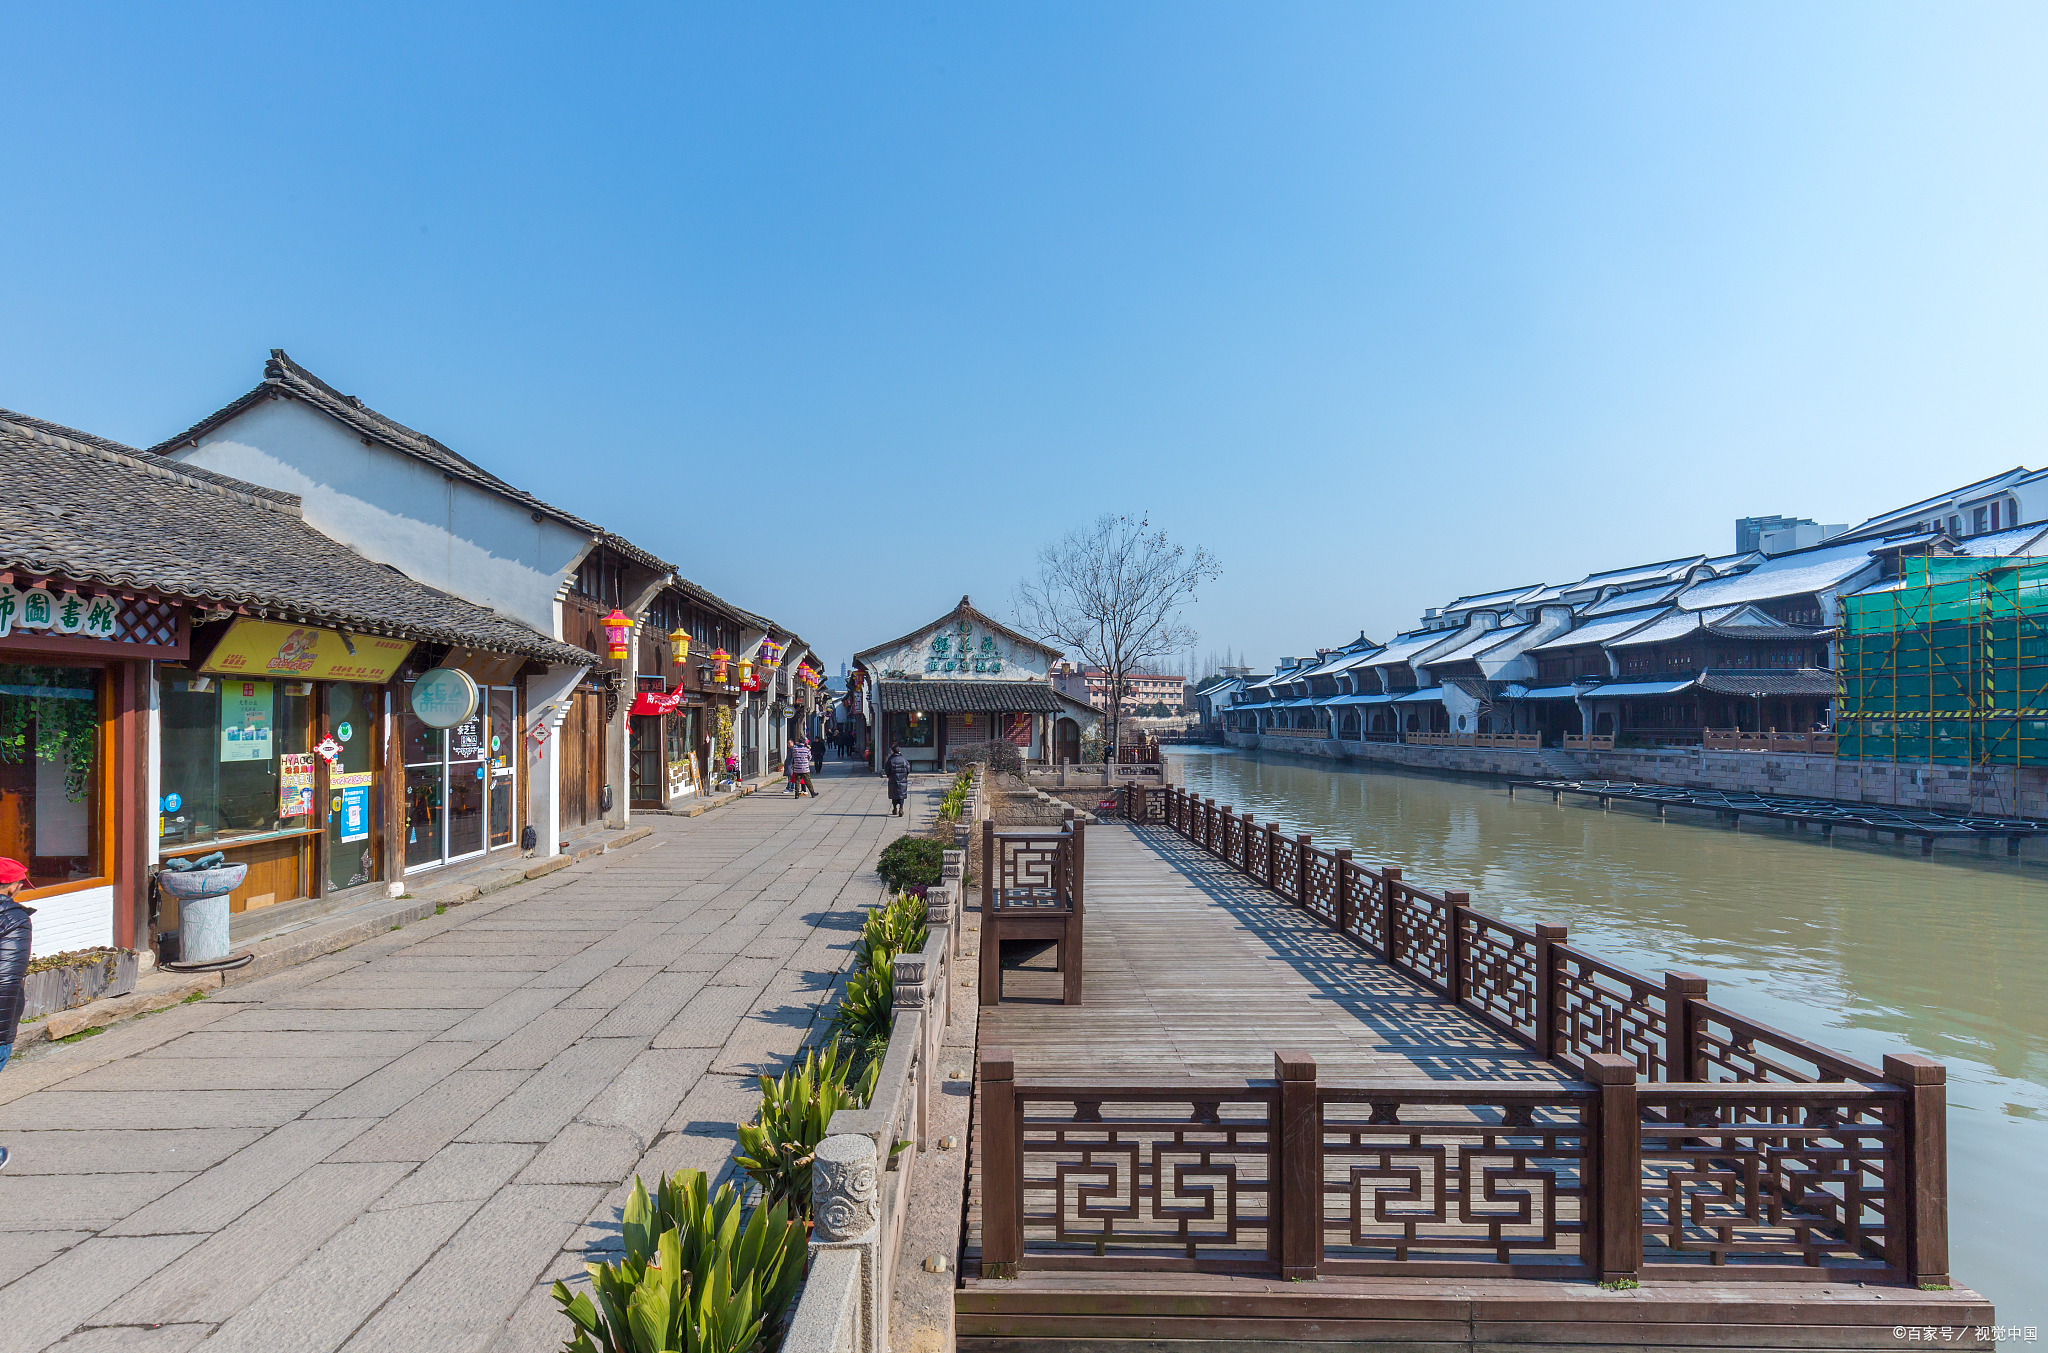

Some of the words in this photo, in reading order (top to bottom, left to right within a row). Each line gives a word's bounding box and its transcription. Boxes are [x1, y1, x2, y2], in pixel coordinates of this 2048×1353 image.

[639, 679, 663, 691] 香烟
[418, 683, 465, 700] TEA
[419, 702, 463, 713] DRINK
